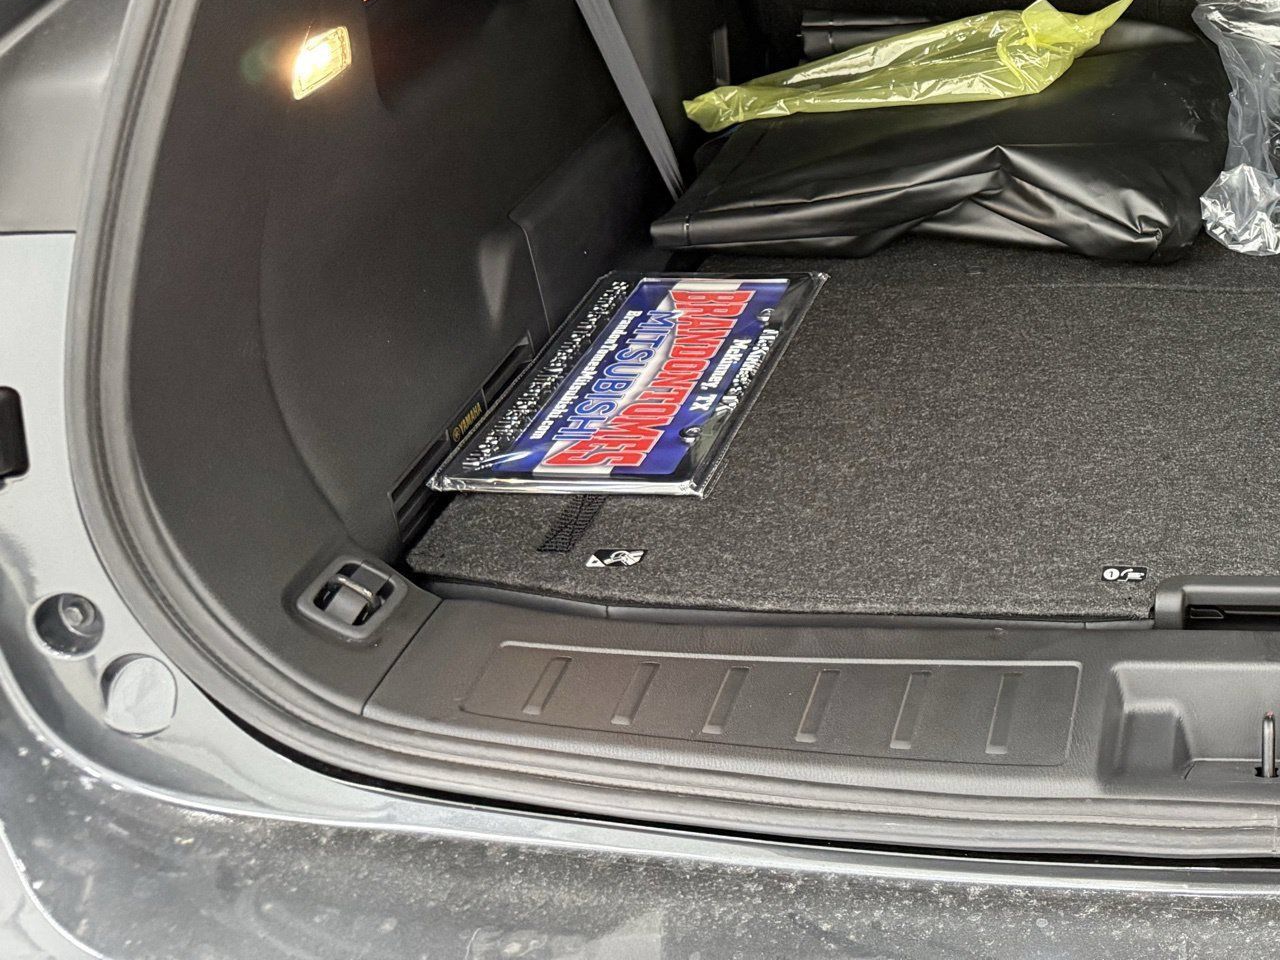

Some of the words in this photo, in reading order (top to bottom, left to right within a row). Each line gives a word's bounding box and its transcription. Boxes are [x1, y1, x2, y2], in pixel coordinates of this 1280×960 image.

[529, 309, 644, 440] BrandonTomesMitsubishi.com
[552, 309, 683, 441] MITSUBISHI
[701, 338, 752, 391] McKinney,
[458, 401, 483, 436] YAMAHA
[689, 393, 718, 411] TX
